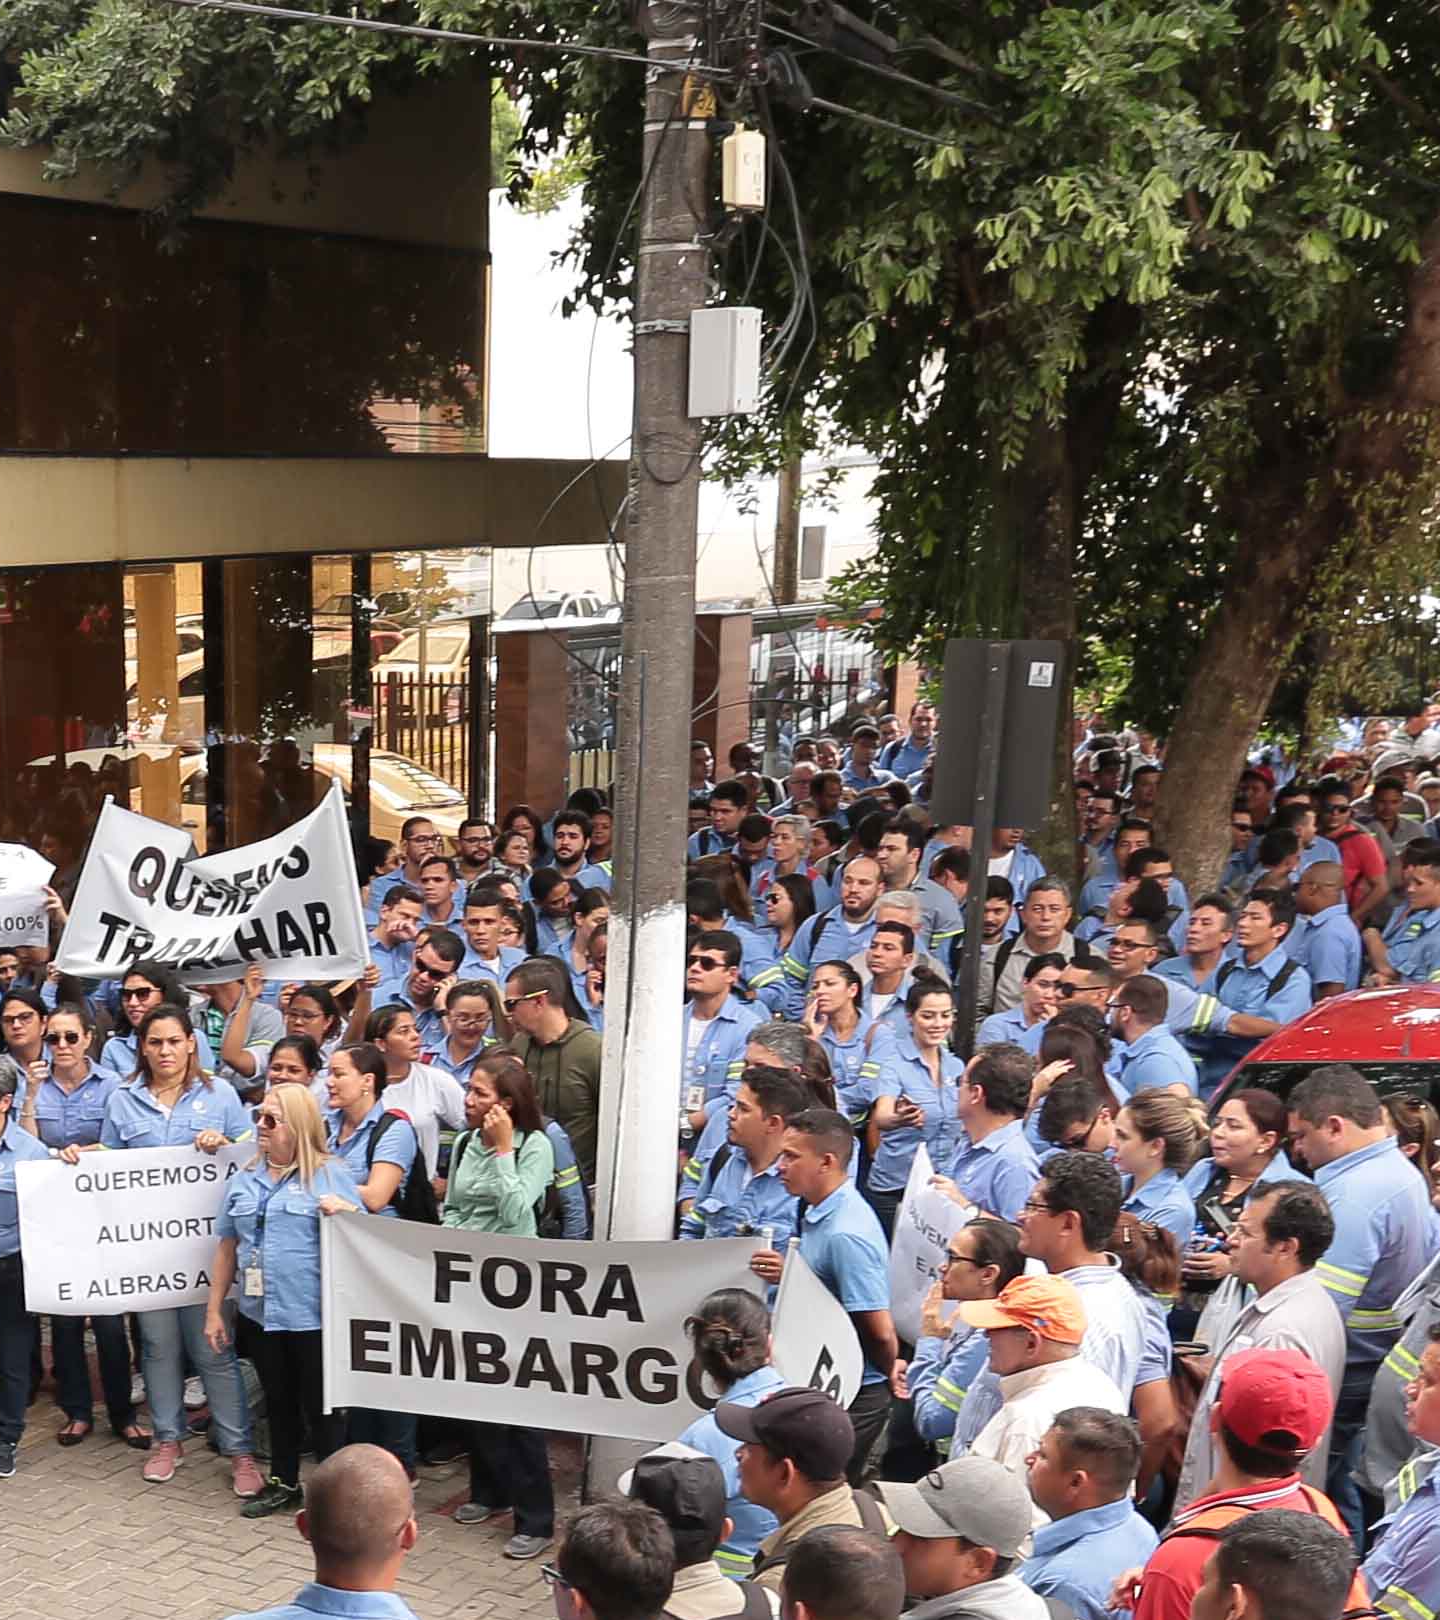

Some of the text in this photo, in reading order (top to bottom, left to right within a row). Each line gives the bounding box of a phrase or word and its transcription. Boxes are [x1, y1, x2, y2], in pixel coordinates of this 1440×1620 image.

[75, 1163, 217, 1193] QUEREMOS
[96, 1216, 216, 1244] ALUNORT
[58, 1282, 72, 1301] E
[87, 1272, 187, 1298] ALBRAS
[432, 1250, 644, 1322] FORA
